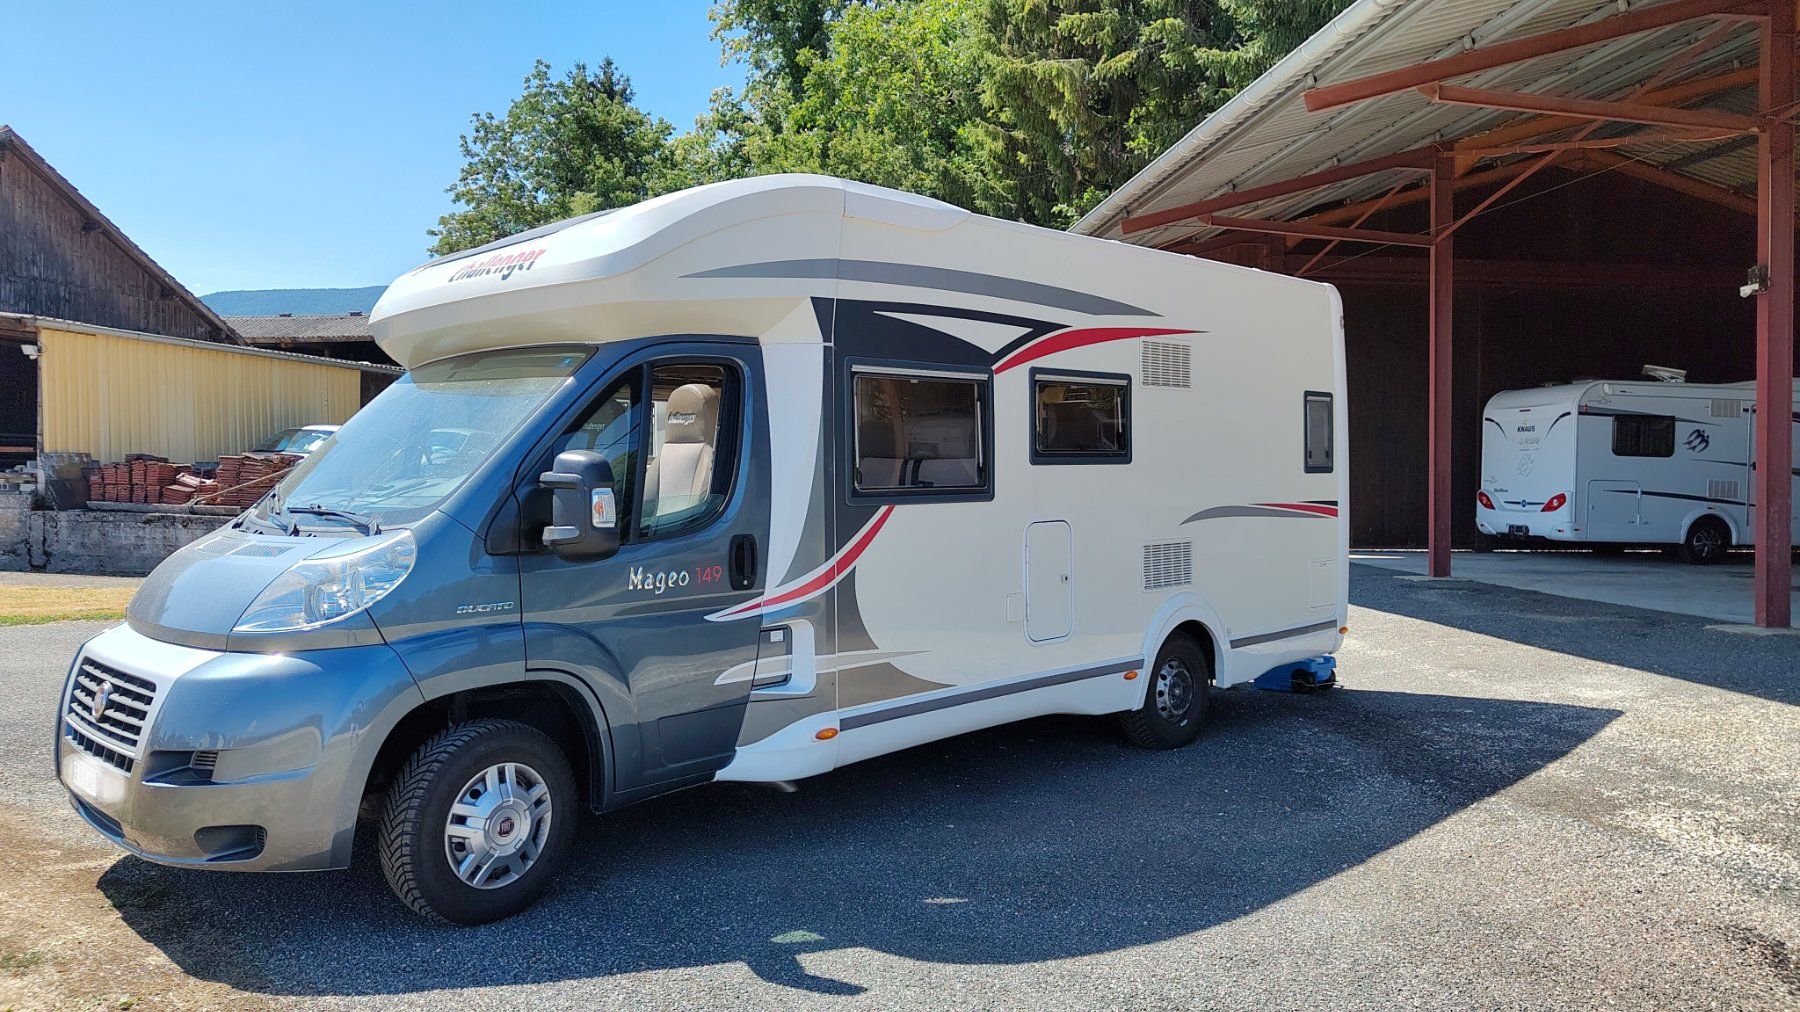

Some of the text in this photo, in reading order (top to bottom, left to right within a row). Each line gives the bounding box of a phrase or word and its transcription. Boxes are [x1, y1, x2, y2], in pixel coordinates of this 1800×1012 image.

[628, 565, 722, 595] Mageo 149
[456, 601, 514, 614] DUCATO
